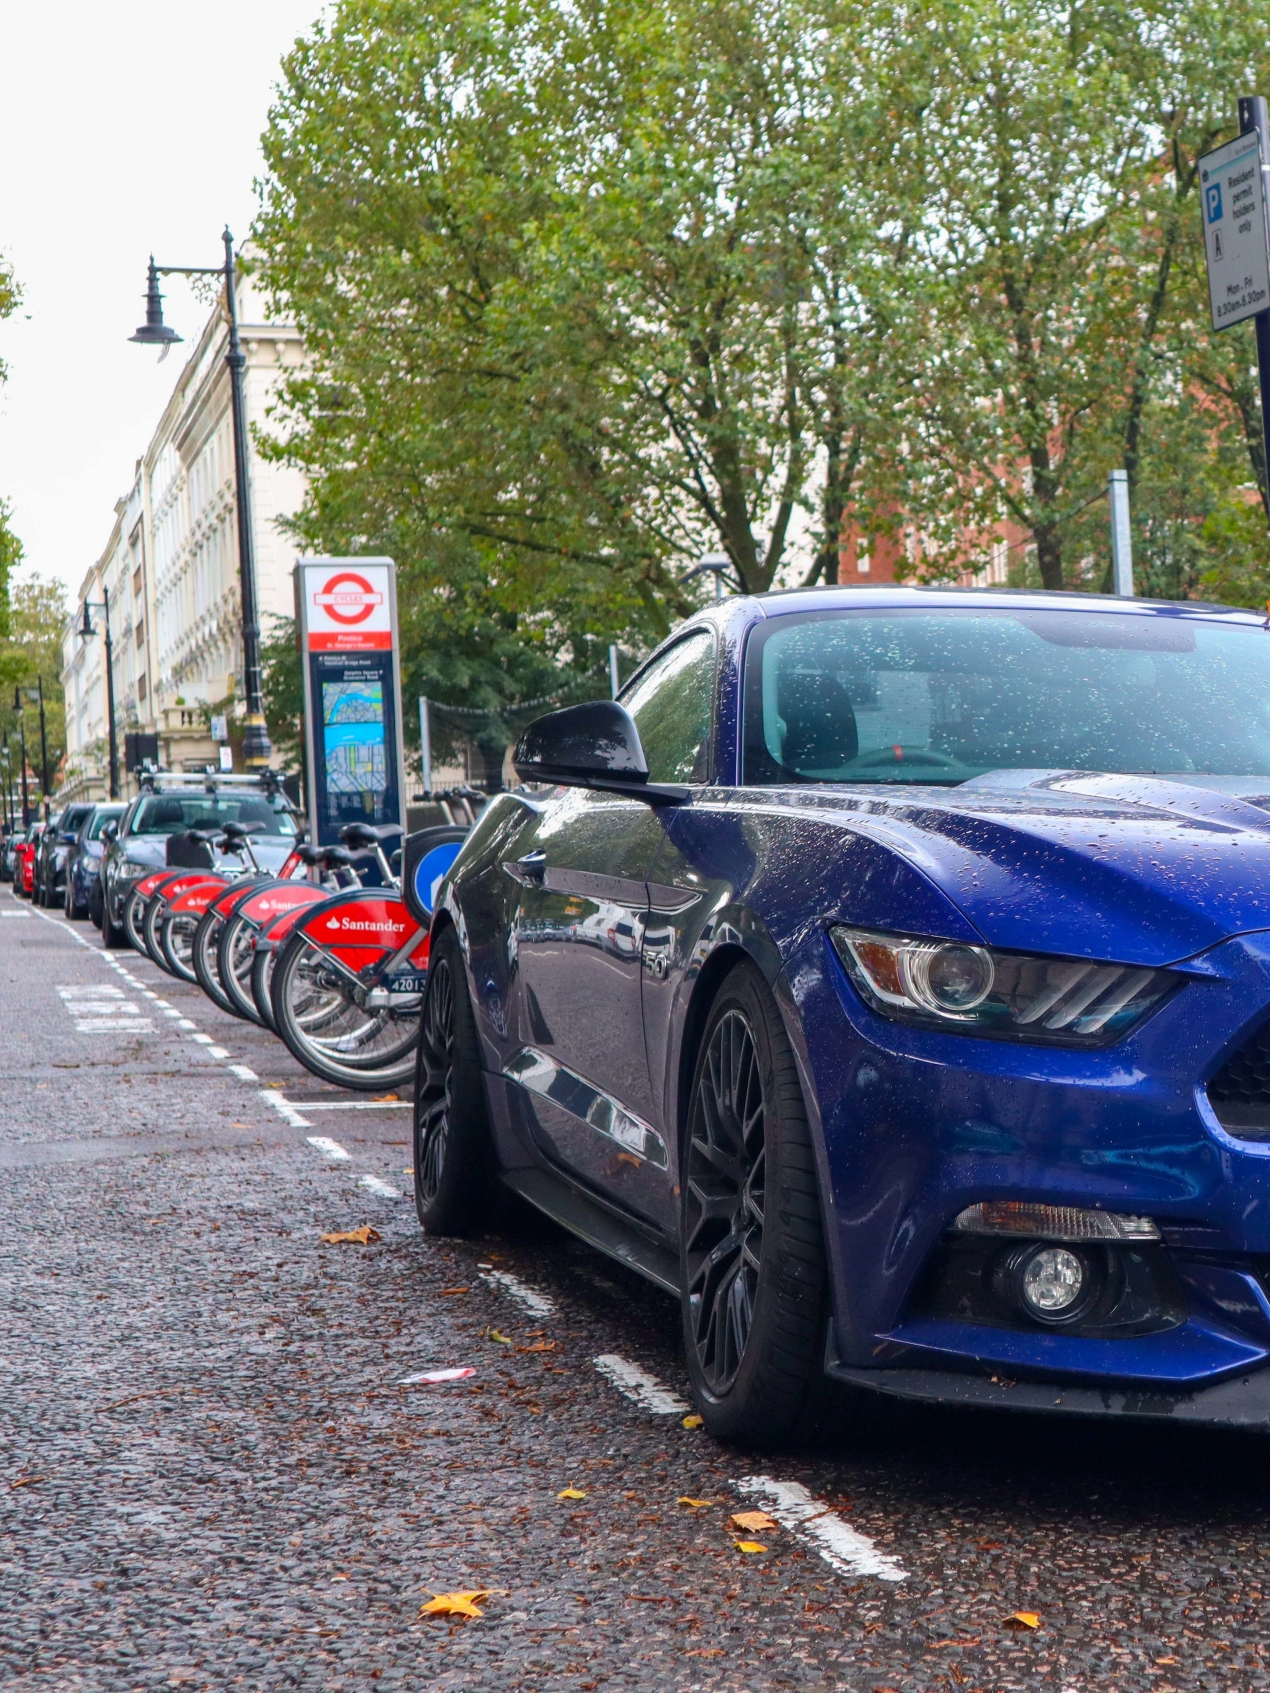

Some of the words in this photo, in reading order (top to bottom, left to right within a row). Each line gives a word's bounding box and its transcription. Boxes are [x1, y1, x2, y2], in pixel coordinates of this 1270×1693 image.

[1228, 167, 1256, 188] Resident
[1208, 188, 1219, 219] P
[1232, 184, 1253, 205] permit
[1233, 201, 1256, 219] holders
[1238, 218, 1252, 234] only
[1215, 233, 1222, 258] A
[1226, 283, 1240, 297] Mon
[1244, 275, 1253, 289] Fri
[341, 917, 406, 932] Santander
